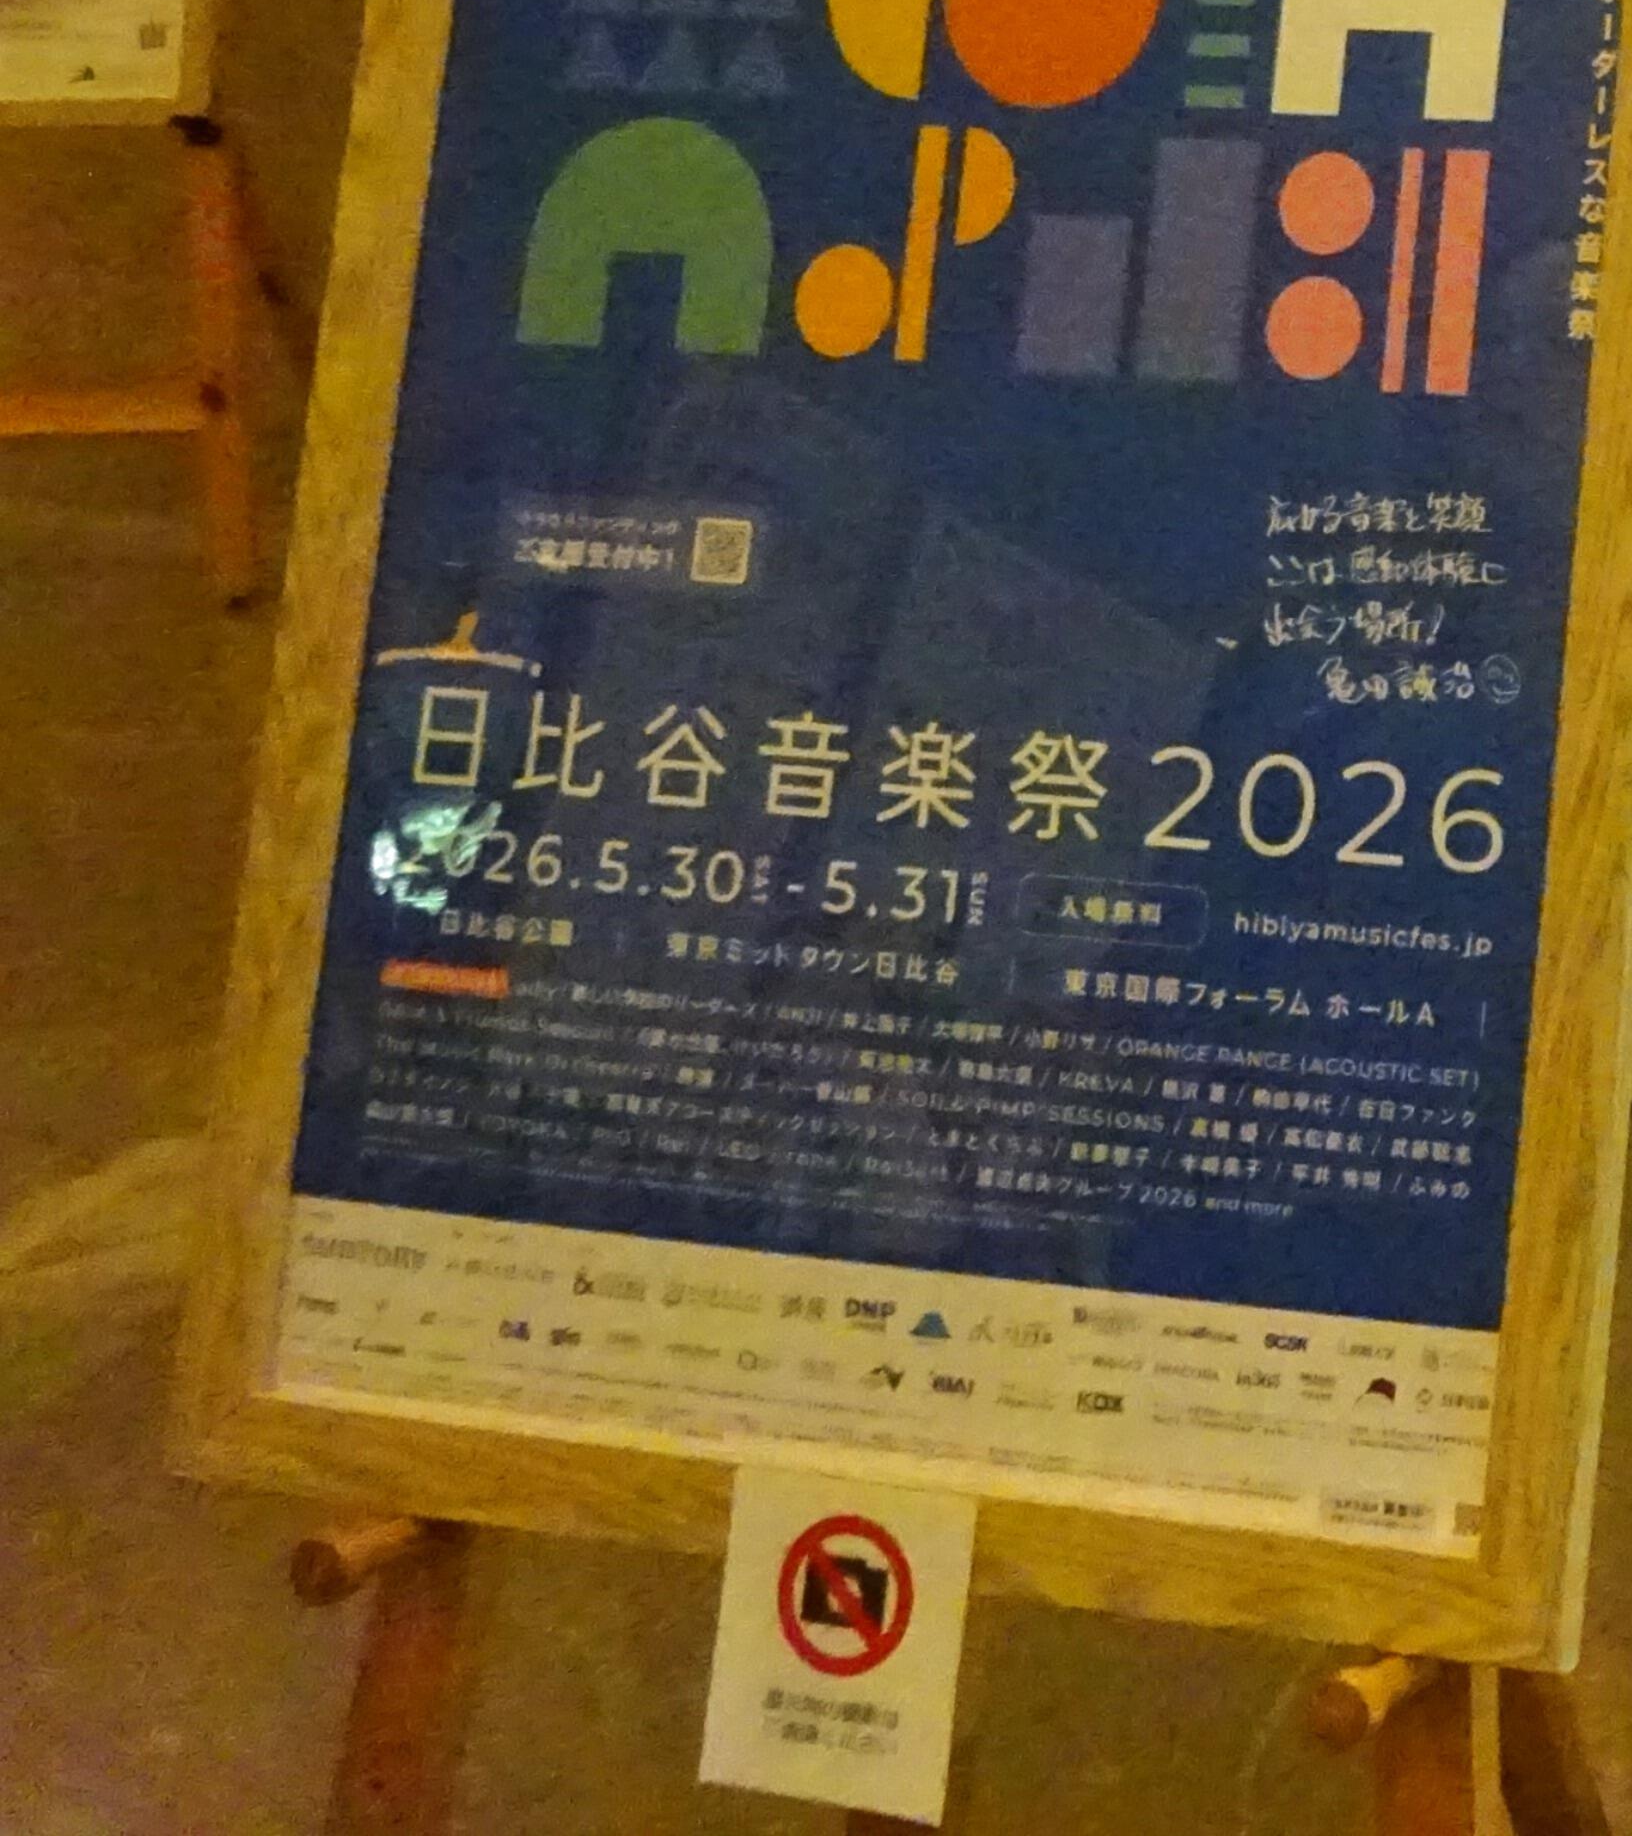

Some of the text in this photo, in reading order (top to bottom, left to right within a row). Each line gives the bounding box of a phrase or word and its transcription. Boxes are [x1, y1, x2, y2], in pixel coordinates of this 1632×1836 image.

[413, 686, 1505, 873] 日比谷音楽祭 2026
[438, 908, 574, 946] 日比谷公園
[1233, 911, 1494, 960] hibiyamusicfes.jp
